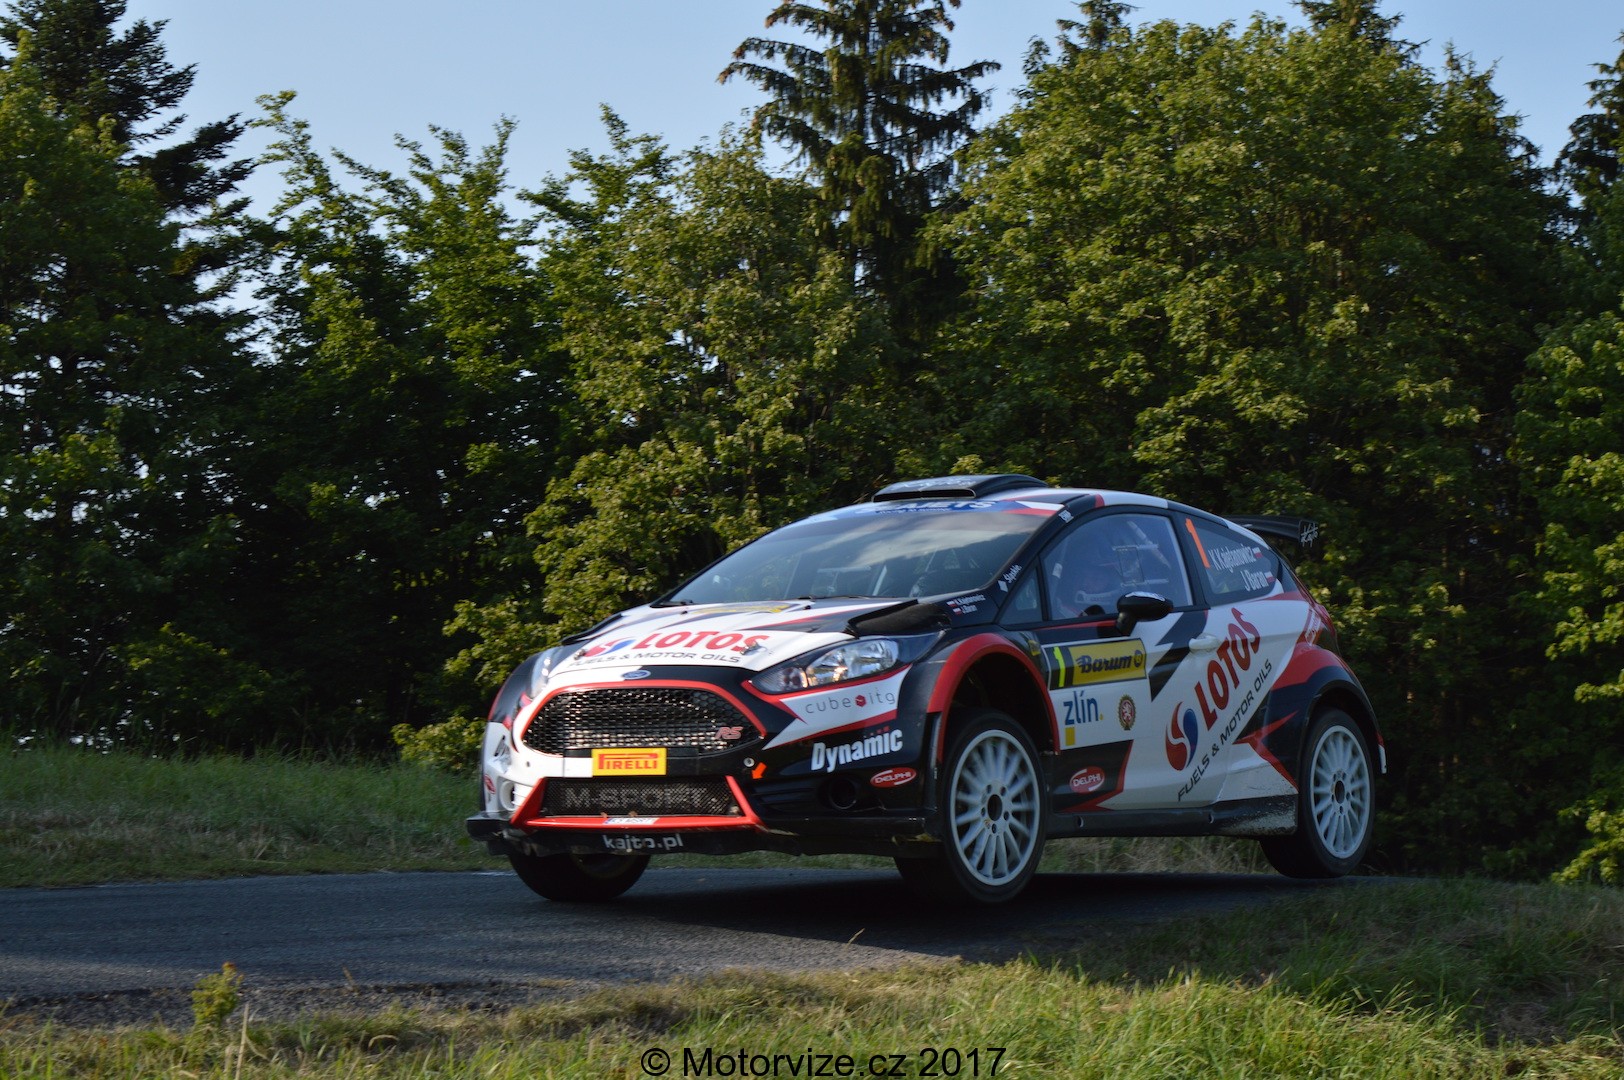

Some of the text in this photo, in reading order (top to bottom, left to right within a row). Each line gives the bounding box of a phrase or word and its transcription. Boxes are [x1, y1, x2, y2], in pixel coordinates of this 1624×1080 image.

[1185, 518, 1210, 568] 1
[632, 631, 770, 653] LOTOS
[701, 653, 740, 663] OILS
[1053, 646, 1066, 687] 1
[1076, 654, 1133, 674] Barum
[1194, 607, 1260, 731] LOTOS
[805, 687, 896, 714] cube itg
[714, 726, 743, 740] RS
[1178, 659, 1272, 801] FUELS & MOTOR OILS
[598, 753, 659, 770] PIRELLI
[811, 729, 903, 773] Dynamic
[875, 771, 912, 784] DELPHI
[1073, 774, 1101, 787] DELPHI
